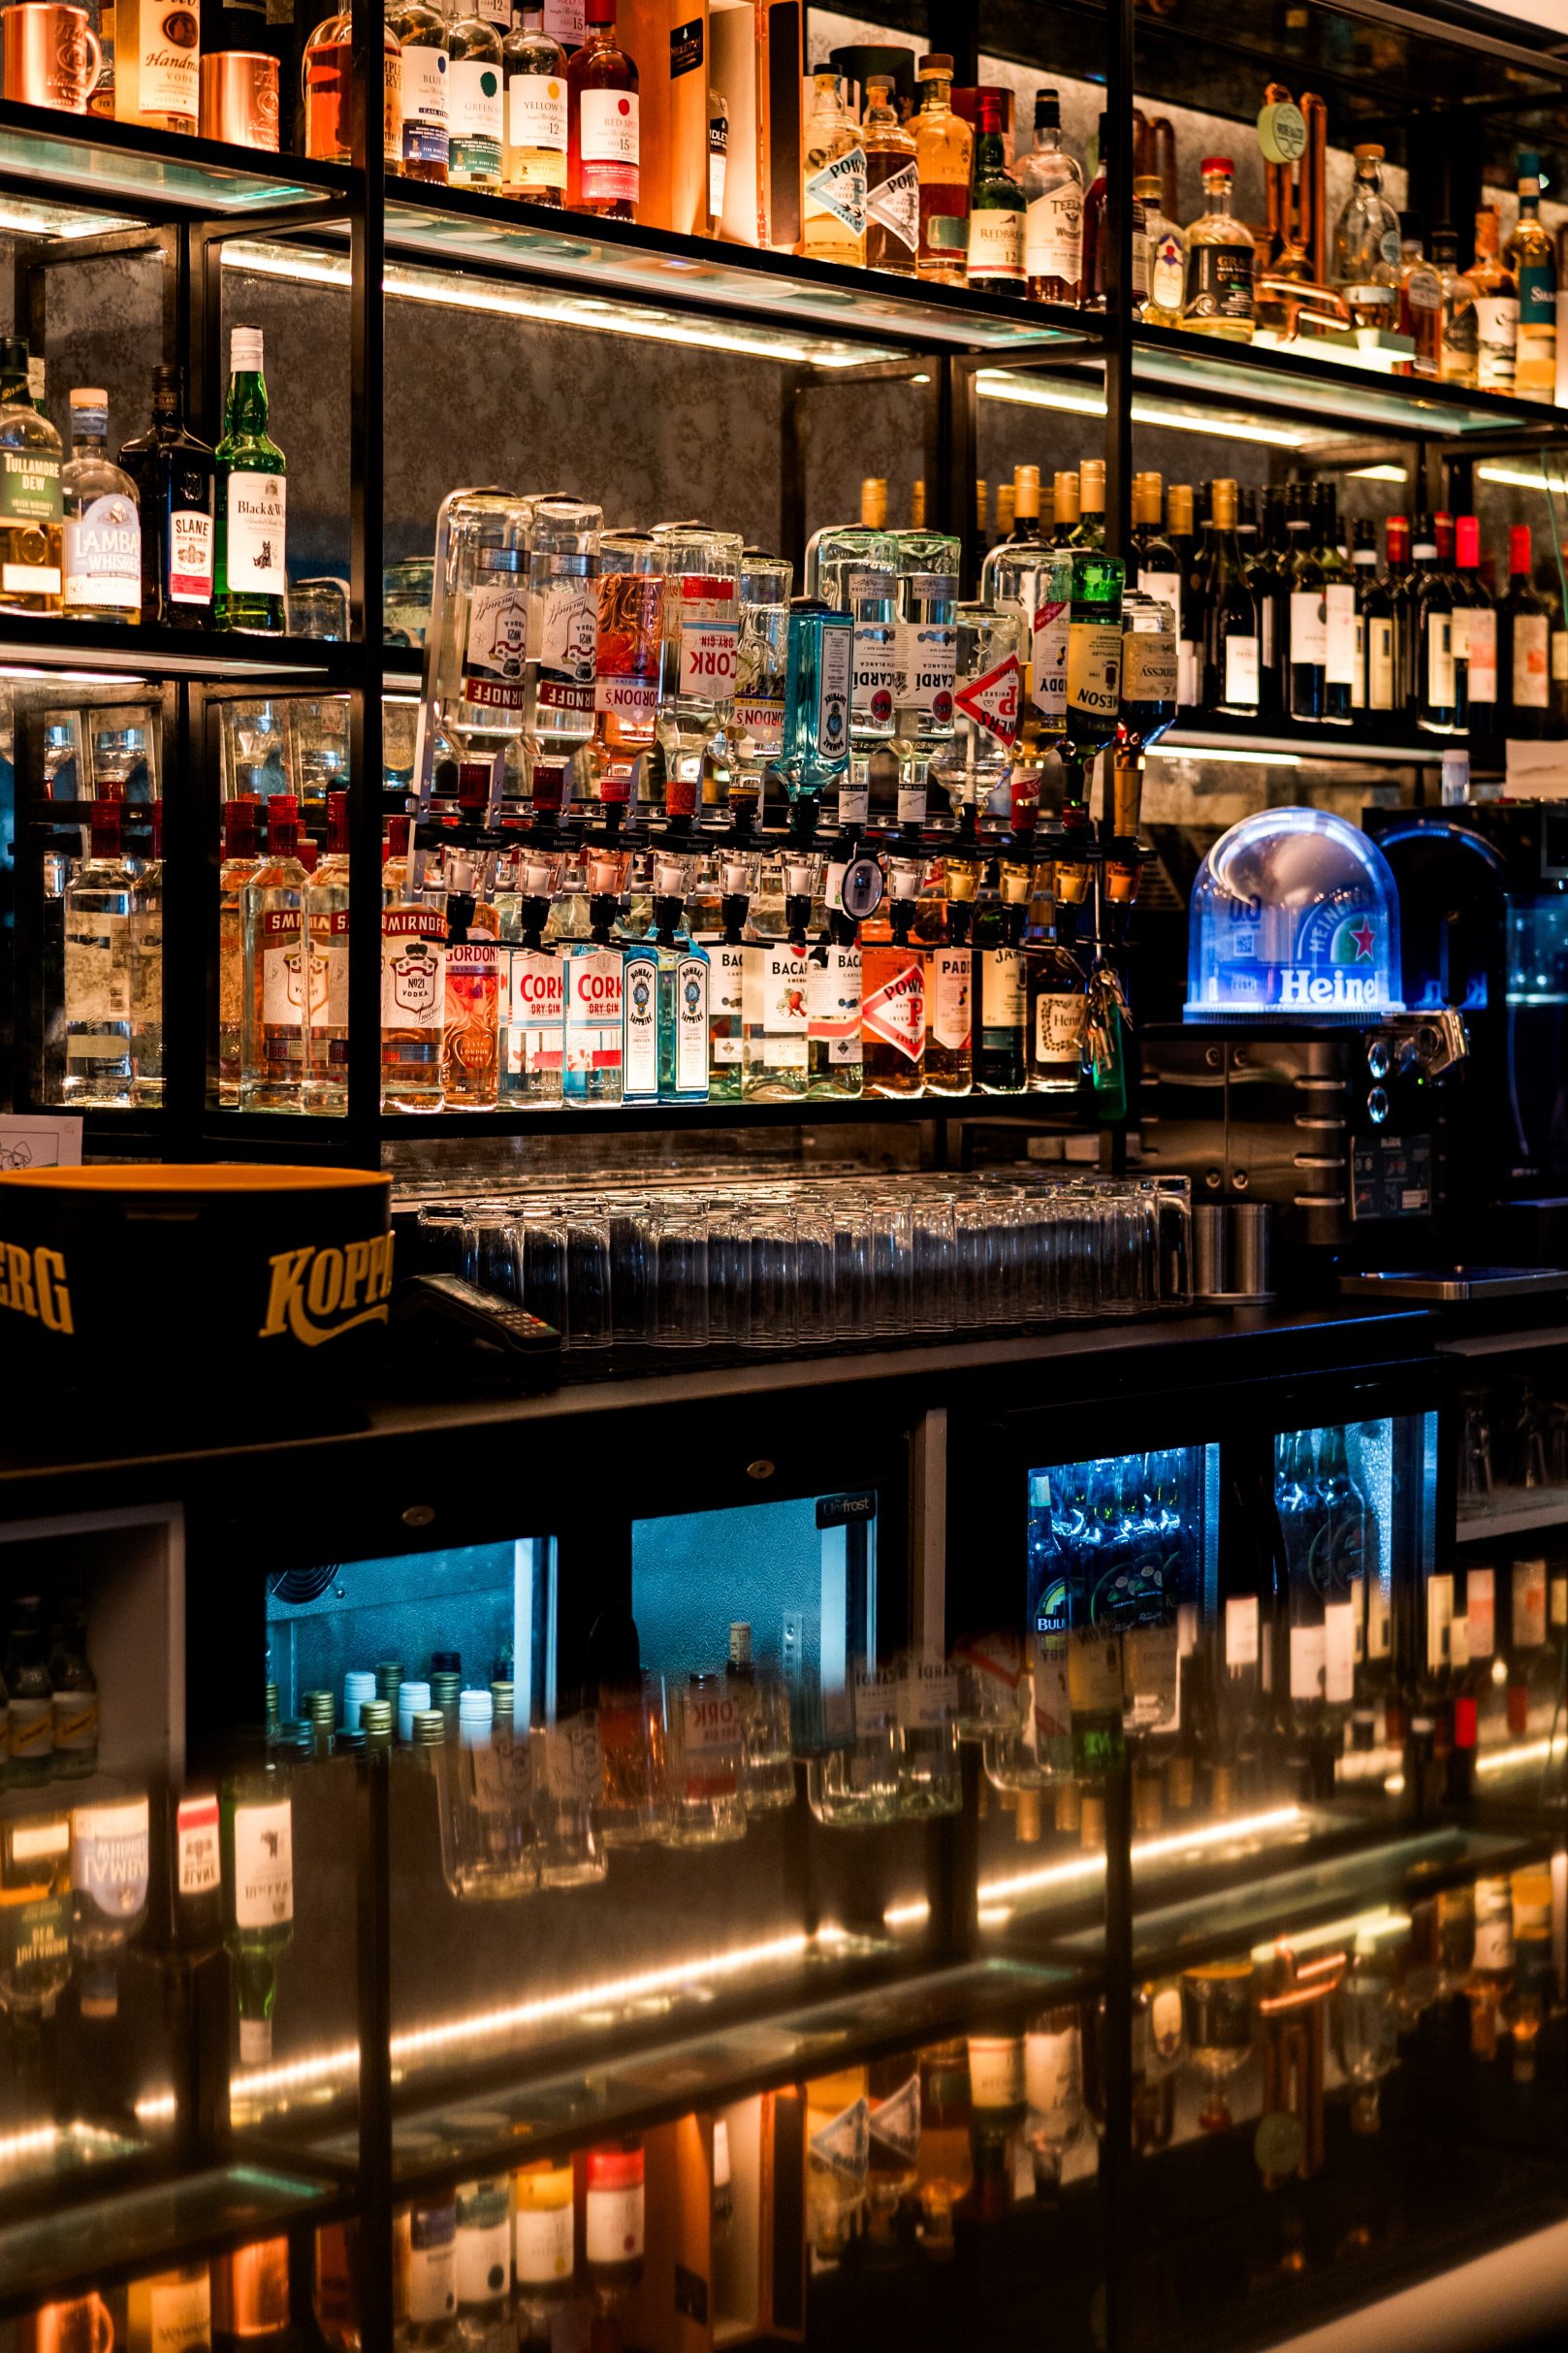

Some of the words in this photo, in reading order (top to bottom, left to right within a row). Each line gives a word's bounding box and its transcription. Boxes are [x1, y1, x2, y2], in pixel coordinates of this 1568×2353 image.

[573, 16, 583, 30] 15
[167, 73, 198, 84] VODK
[464, 102, 493, 113] GREEN
[525, 101, 558, 112] YELLOW
[549, 123, 560, 135] 12
[604, 118, 622, 127] RED
[620, 139, 630, 150] 15
[1006, 251, 1016, 262] 12
[3, 452, 60, 478] TULLAMORE
[21, 474, 46, 492] DEW
[176, 519, 209, 536] SLANE
[701, 636, 716, 647] GIN
[719, 637, 734, 648] DRY
[689, 651, 737, 679] CORK
[853, 672, 895, 690] CARDÍ
[915, 673, 955, 691] CARDÍ
[548, 688, 594, 707] IRNOFF
[823, 693, 847, 707] SAPPHIRE
[999, 686, 1017, 716] P
[822, 737, 844, 752] BOMBAY
[630, 968, 652, 983] BOMBAY
[682, 967, 704, 981] BOMBAY
[520, 974, 563, 1002] CORK
[578, 974, 622, 1002] CORK
[530, 1004, 545, 1015] DRY
[548, 1003, 560, 1014] GIN
[590, 1003, 602, 1015] DRY
[606, 1003, 619, 1014] GIN
[907, 998, 923, 1027] P
[629, 1012, 653, 1025] SAPPHIRE
[681, 1011, 704, 1024] SAPPHIRE
